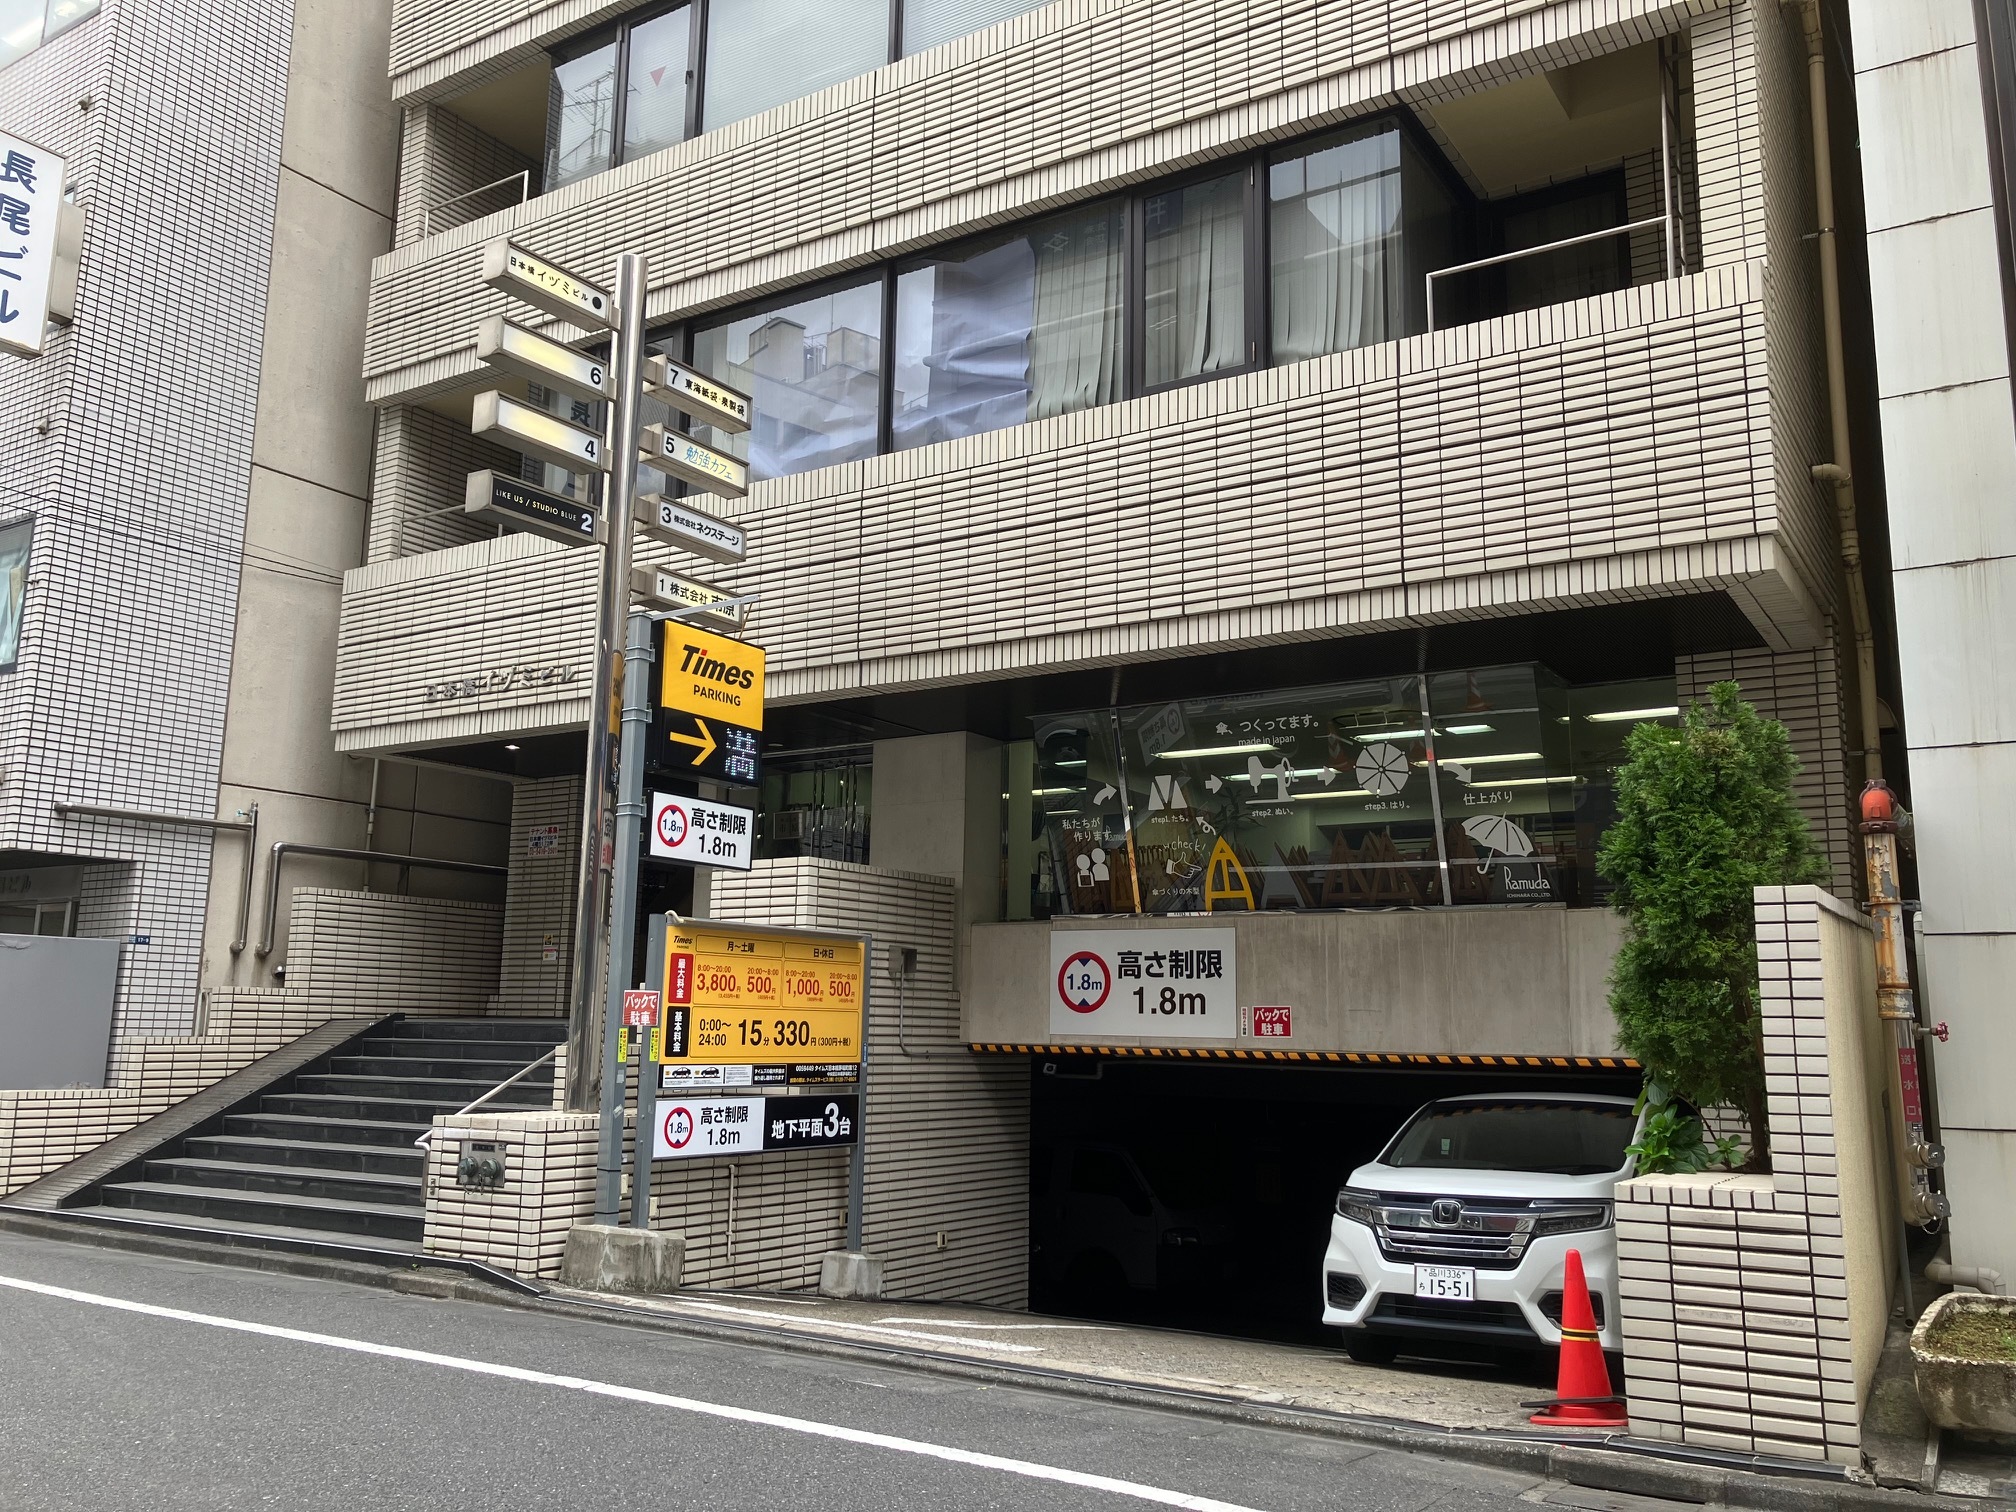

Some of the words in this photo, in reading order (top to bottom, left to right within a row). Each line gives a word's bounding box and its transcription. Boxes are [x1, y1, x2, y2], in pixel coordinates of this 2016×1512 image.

[590, 366, 602, 385] 6
[670, 368, 679, 385] 7
[584, 440, 596, 458] 4
[665, 436, 675, 454] 5
[684, 446, 733, 480] 勉強カフェ
[495, 488, 511, 500] LIKE
[513, 494, 524, 504] US
[532, 501, 559, 515] STUDIO
[560, 510, 577, 522] BLUE
[580, 513, 593, 533] 2
[661, 506, 672, 524] 3
[659, 578, 665, 592] 1
[669, 581, 708, 605] 株式会社
[680, 644, 755, 690] Times
[693, 684, 742, 707] PARKING
[1239, 713, 1319, 732] つくってます。
[1238, 736, 1261, 747] made
[1262, 735, 1271, 745] in
[1272, 735, 1296, 746] japan
[1462, 790, 1513, 806] 仕上がり
[662, 818, 683, 833] 1.8m
[690, 807, 746, 836] 高さ制限
[1062, 816, 1101, 830] 私たちが
[698, 833, 737, 858] 1.8m
[1503, 863, 1551, 890] Ramuda
[673, 935, 693, 945] Times
[1117, 949, 1223, 980] 高さ制限
[676, 958, 686, 999] 最大料金
[1066, 973, 1103, 991] 1.8m
[625, 993, 657, 1010] バックで
[1132, 986, 1206, 1015] 1.8m
[629, 1010, 651, 1026] 駐車
[1254, 1008, 1290, 1022] バックで
[672, 1011, 683, 1053] 基本料金
[1261, 1022, 1284, 1036] 駐車
[698, 1032, 727, 1046] 24:00
[700, 1105, 749, 1125] 高さ制限
[771, 1102, 852, 1140] 地下平面3台
[669, 1122, 689, 1134] 1.8m
[707, 1128, 741, 1146] 1.8m
[1418, 1282, 1426, 1291] ち
